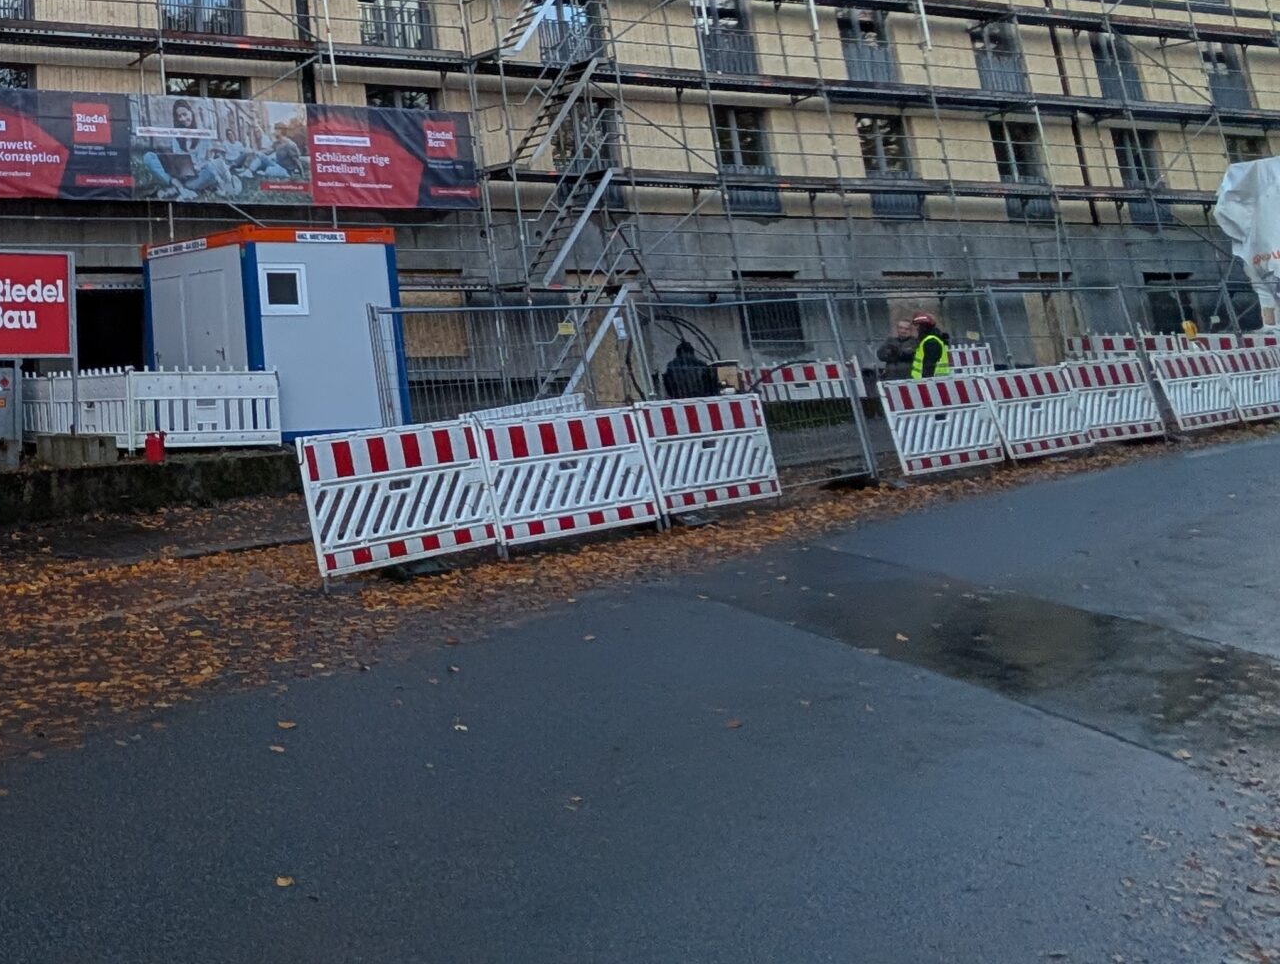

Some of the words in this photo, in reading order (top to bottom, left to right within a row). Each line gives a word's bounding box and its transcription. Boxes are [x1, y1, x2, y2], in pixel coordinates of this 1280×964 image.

[76, 114, 108, 124] Riedel
[76, 123, 97, 132] Bau
[426, 130, 454, 140] Riedel
[315, 152, 390, 167] Schlüsselfertige
[316, 163, 366, 177] Erstellung
